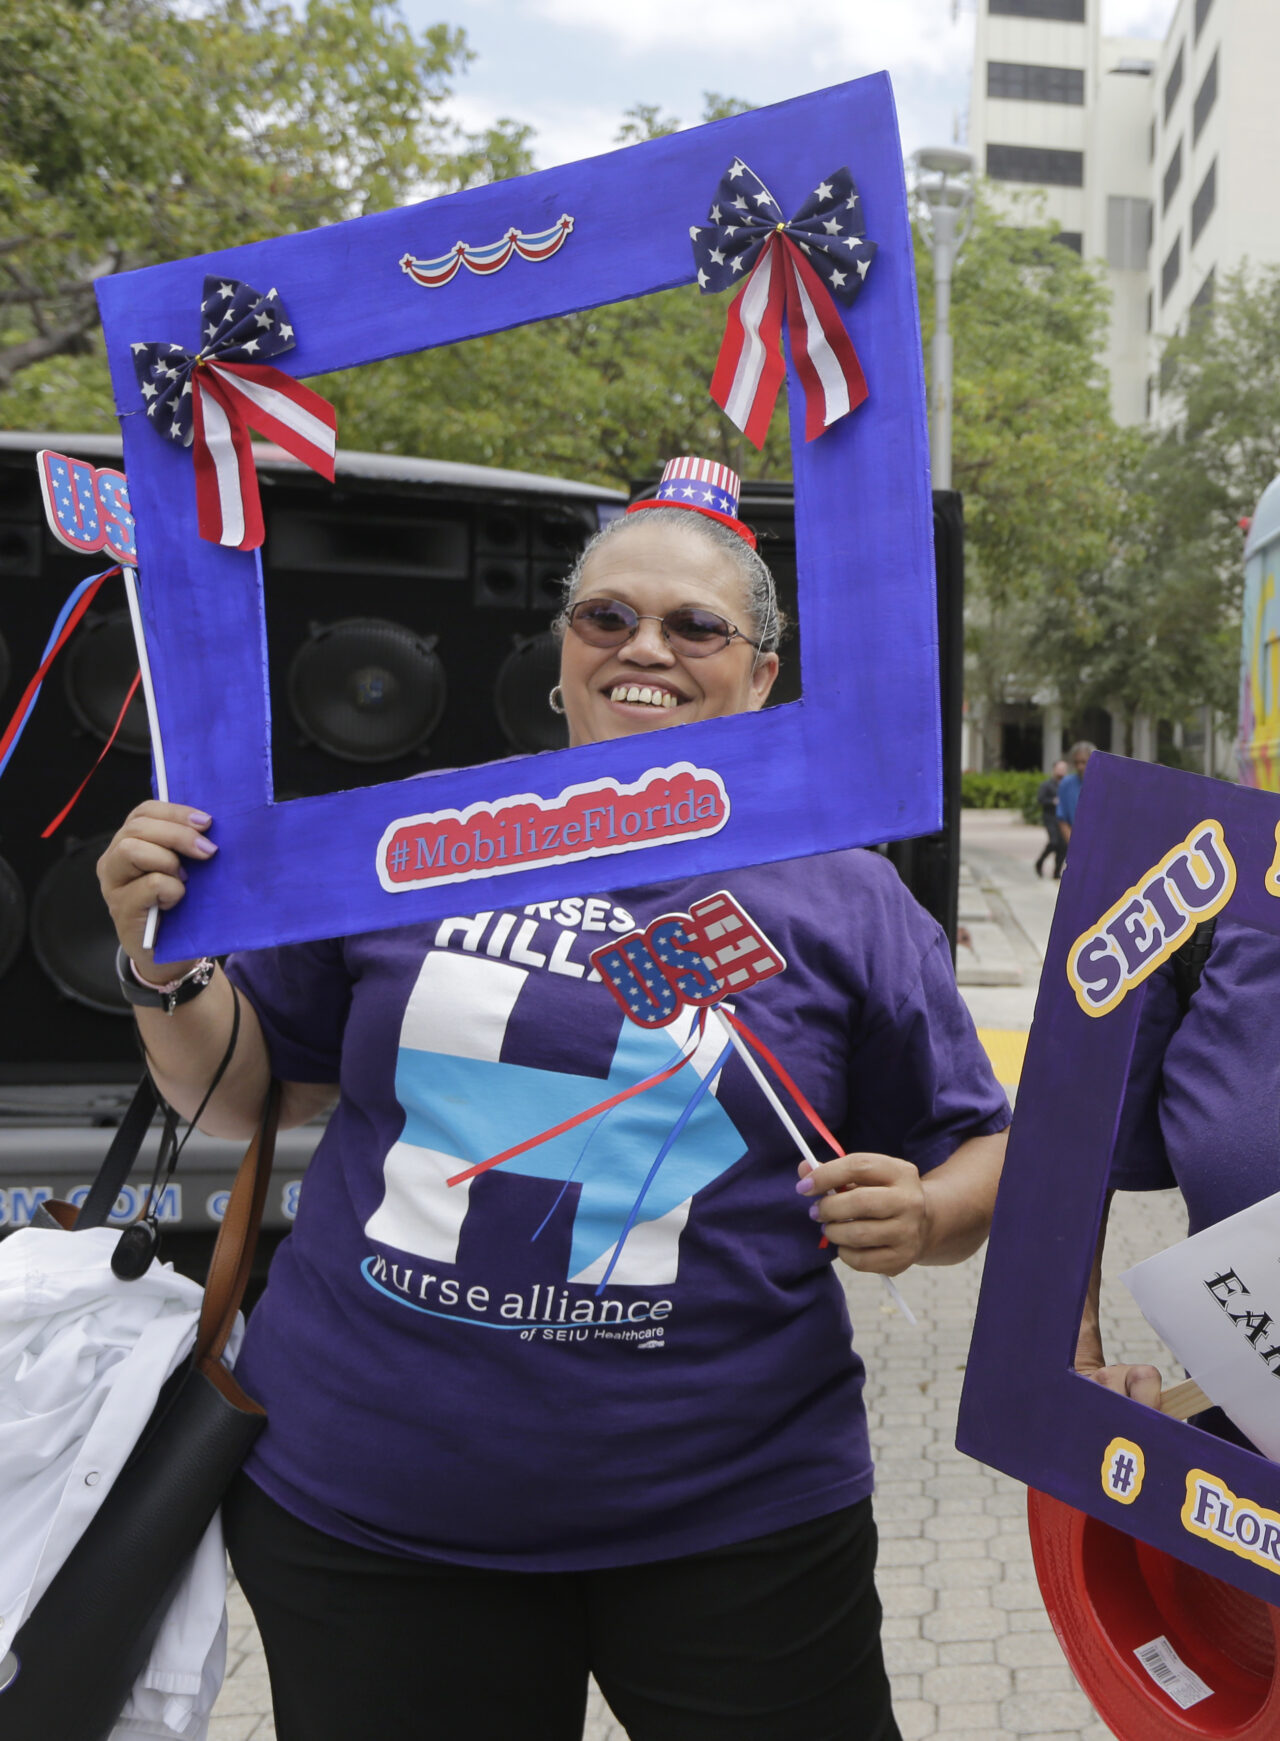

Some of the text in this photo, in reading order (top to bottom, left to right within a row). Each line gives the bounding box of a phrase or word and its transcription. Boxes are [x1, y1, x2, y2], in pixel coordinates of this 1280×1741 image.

[47, 455, 137, 556] US
[390, 788, 719, 873] #MobilizeFlorida
[434, 911, 602, 982] HILL
[1075, 830, 1226, 1000] SEIU
[371, 1254, 674, 1324] nurse alliance
[519, 1325, 665, 1342] of SEIU Healthcare
[1111, 1454, 1135, 1494] #
